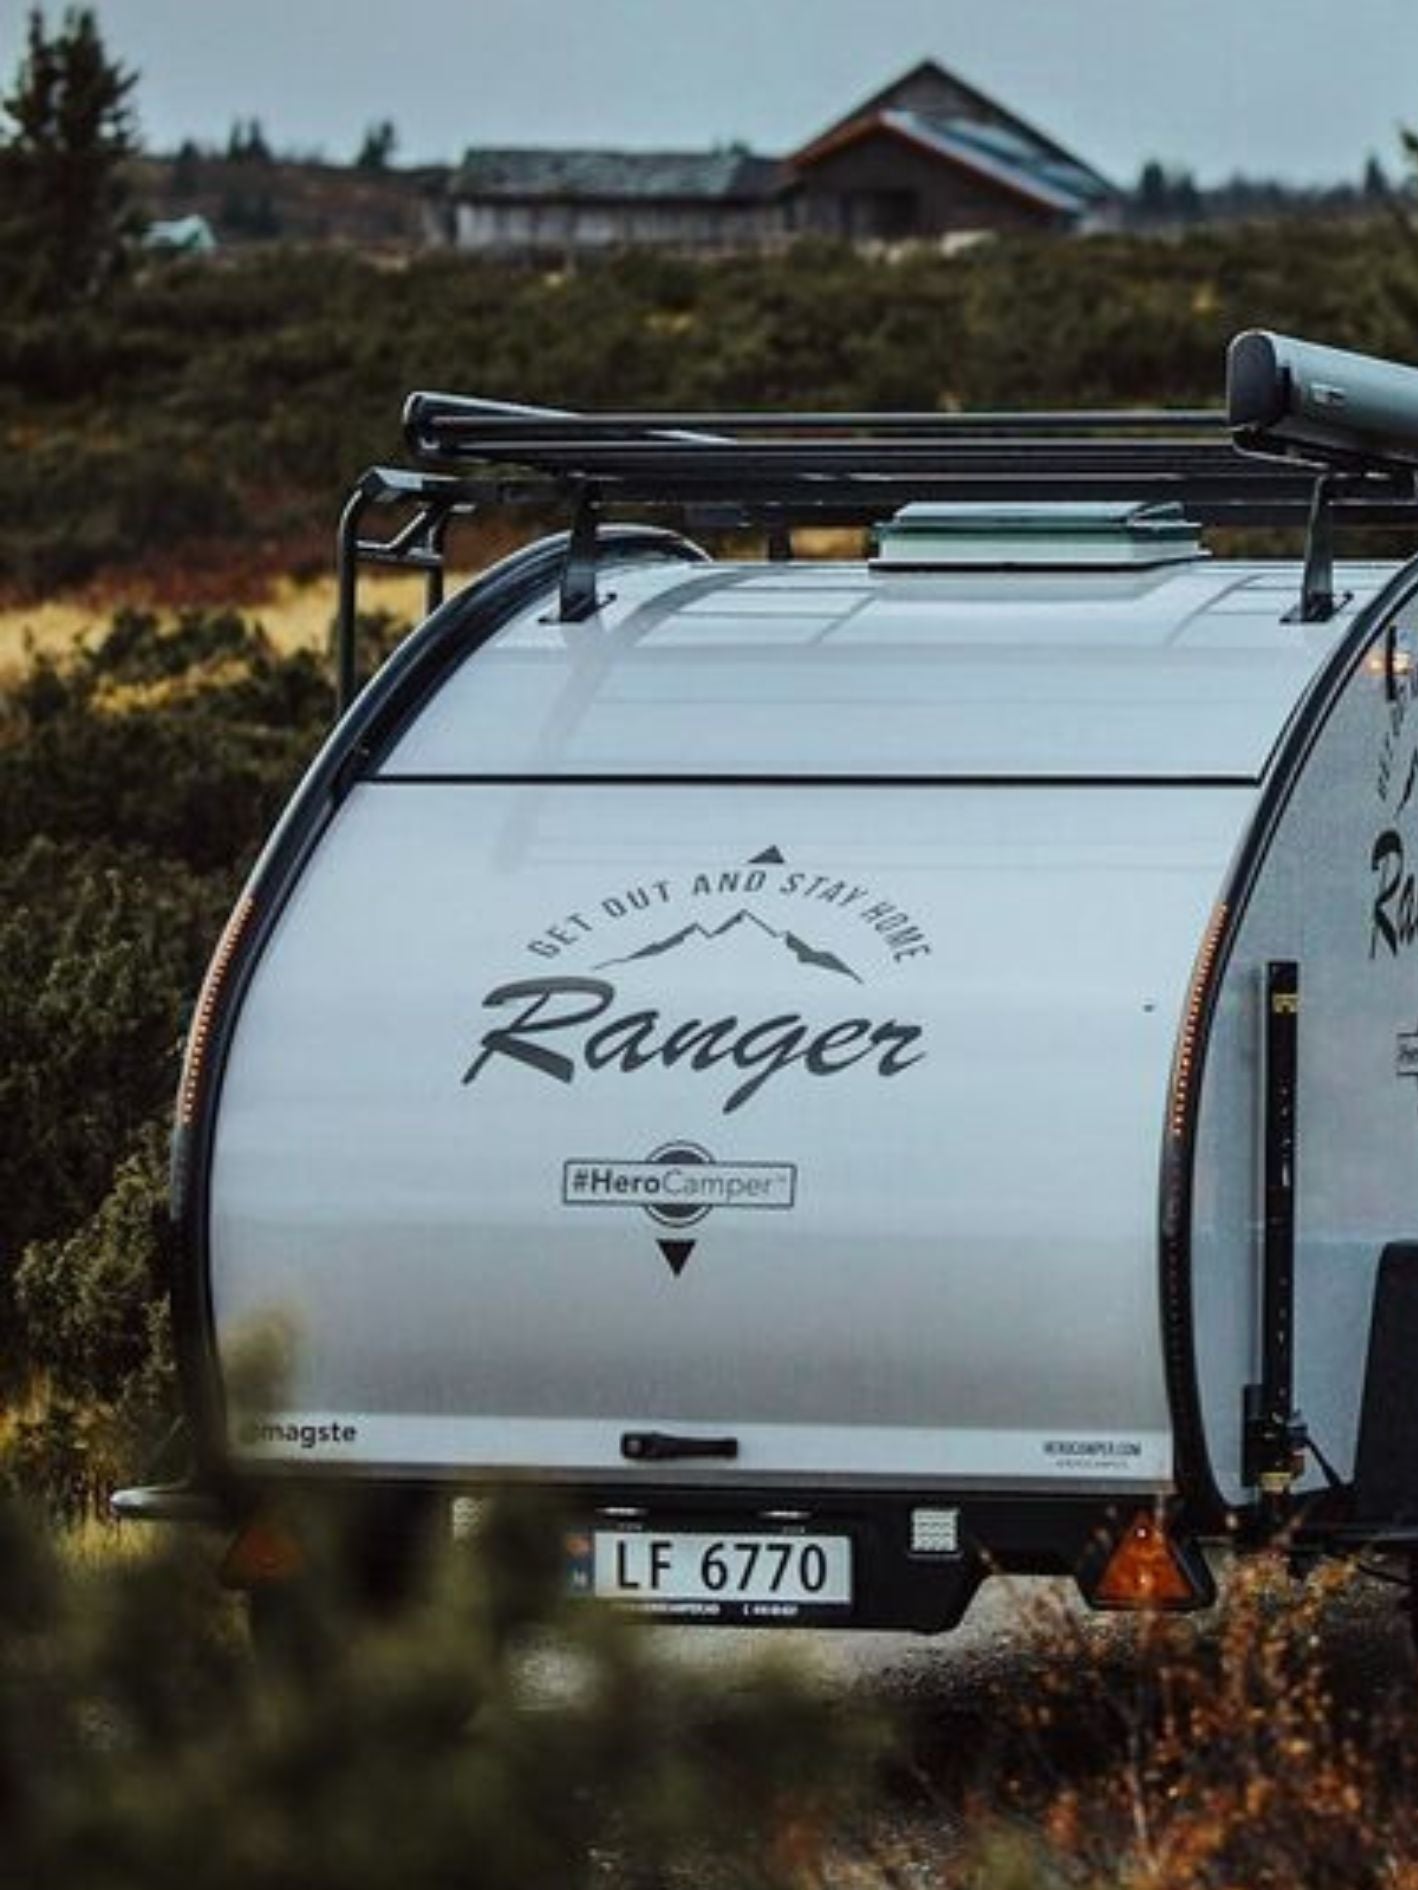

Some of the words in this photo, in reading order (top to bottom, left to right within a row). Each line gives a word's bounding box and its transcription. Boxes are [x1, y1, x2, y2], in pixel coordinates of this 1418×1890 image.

[527, 913, 592, 959] GET
[602, 880, 671, 919] OUT
[692, 870, 767, 896] AND
[779, 872, 869, 907] STAY
[859, 901, 932, 963] HOME
[461, 976, 926, 1114] Ranger
[616, 1540, 673, 1589] LF
[701, 1541, 828, 1593] 6770
